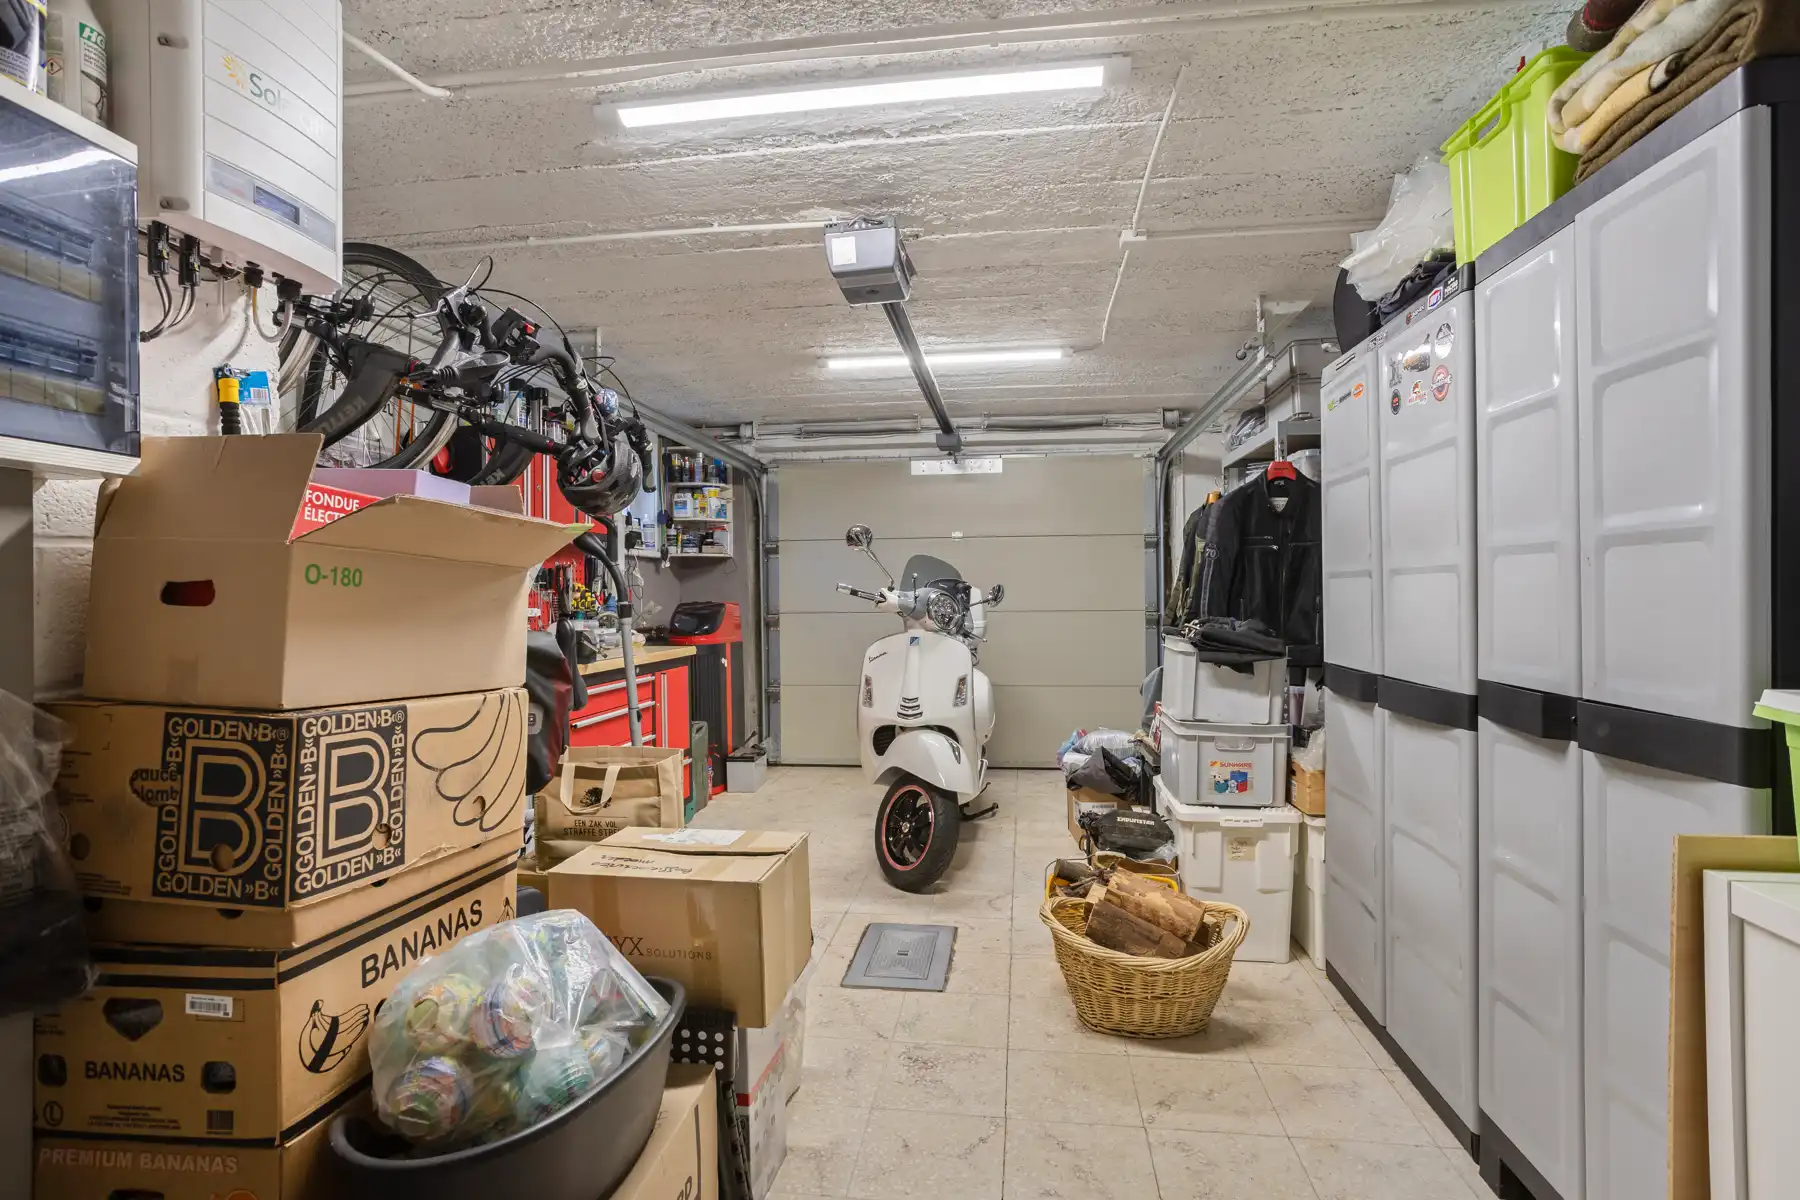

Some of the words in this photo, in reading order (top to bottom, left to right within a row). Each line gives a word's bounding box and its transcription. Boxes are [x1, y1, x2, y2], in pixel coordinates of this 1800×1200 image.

[305, 489, 360, 511] FONDUE
[1204, 549, 1217, 558] 70
[305, 563, 363, 588] O-180
[296, 774, 317, 873] GOLDEN
[563, 828, 597, 837] STRAFFE
[598, 829, 621, 837] STRE
[574, 819, 586, 828] EEN
[589, 820, 602, 828] ZAK
[157, 871, 242, 898] GOLDEN
[295, 853, 374, 894] GOLDEN
[361, 899, 483, 989] BANANAS
[646, 947, 712, 960] SOLUTIONS
[85, 1061, 185, 1082] BANANAS
[38, 1148, 133, 1169] PREMIUM
[140, 1154, 238, 1174] BANANAS
